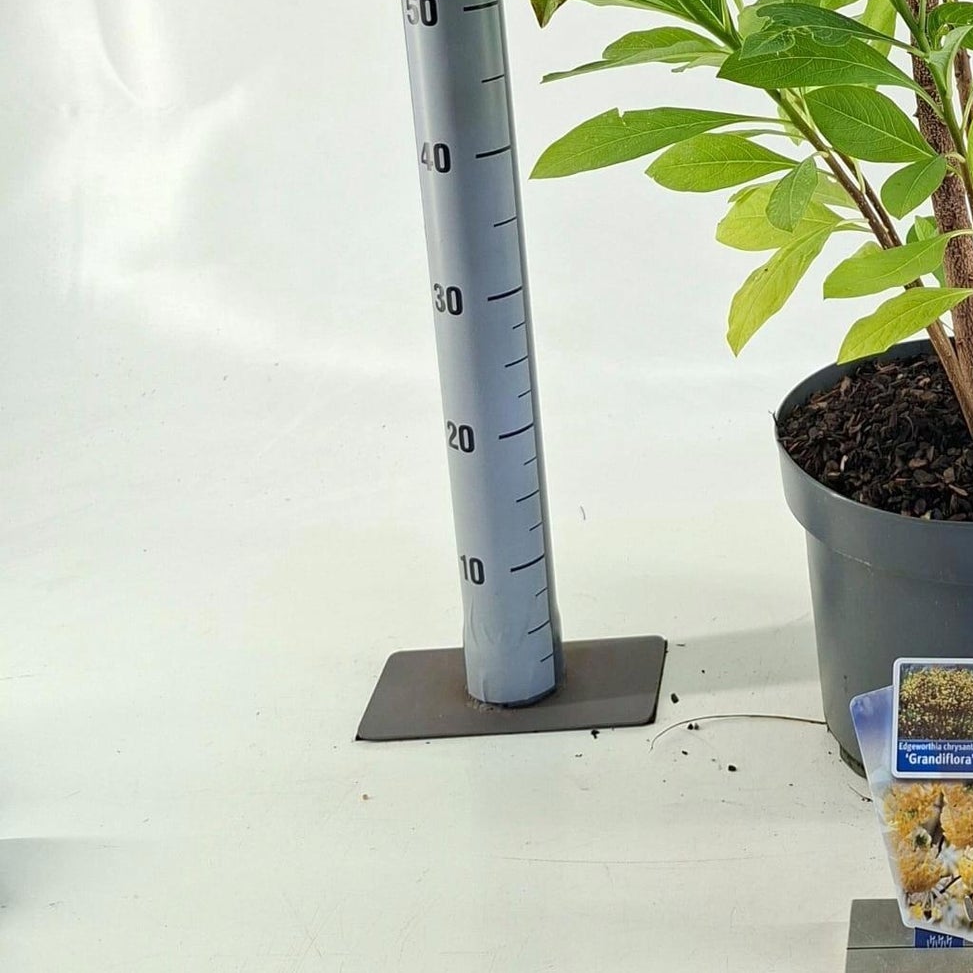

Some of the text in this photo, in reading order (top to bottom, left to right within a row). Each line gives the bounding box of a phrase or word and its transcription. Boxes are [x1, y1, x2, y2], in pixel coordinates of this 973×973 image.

[420, 142, 451, 173] 40
[433, 283, 463, 316] 30
[446, 421, 476, 453] 20
[460, 555, 486, 585] 10
[898, 742, 941, 752] Edgeworthia
